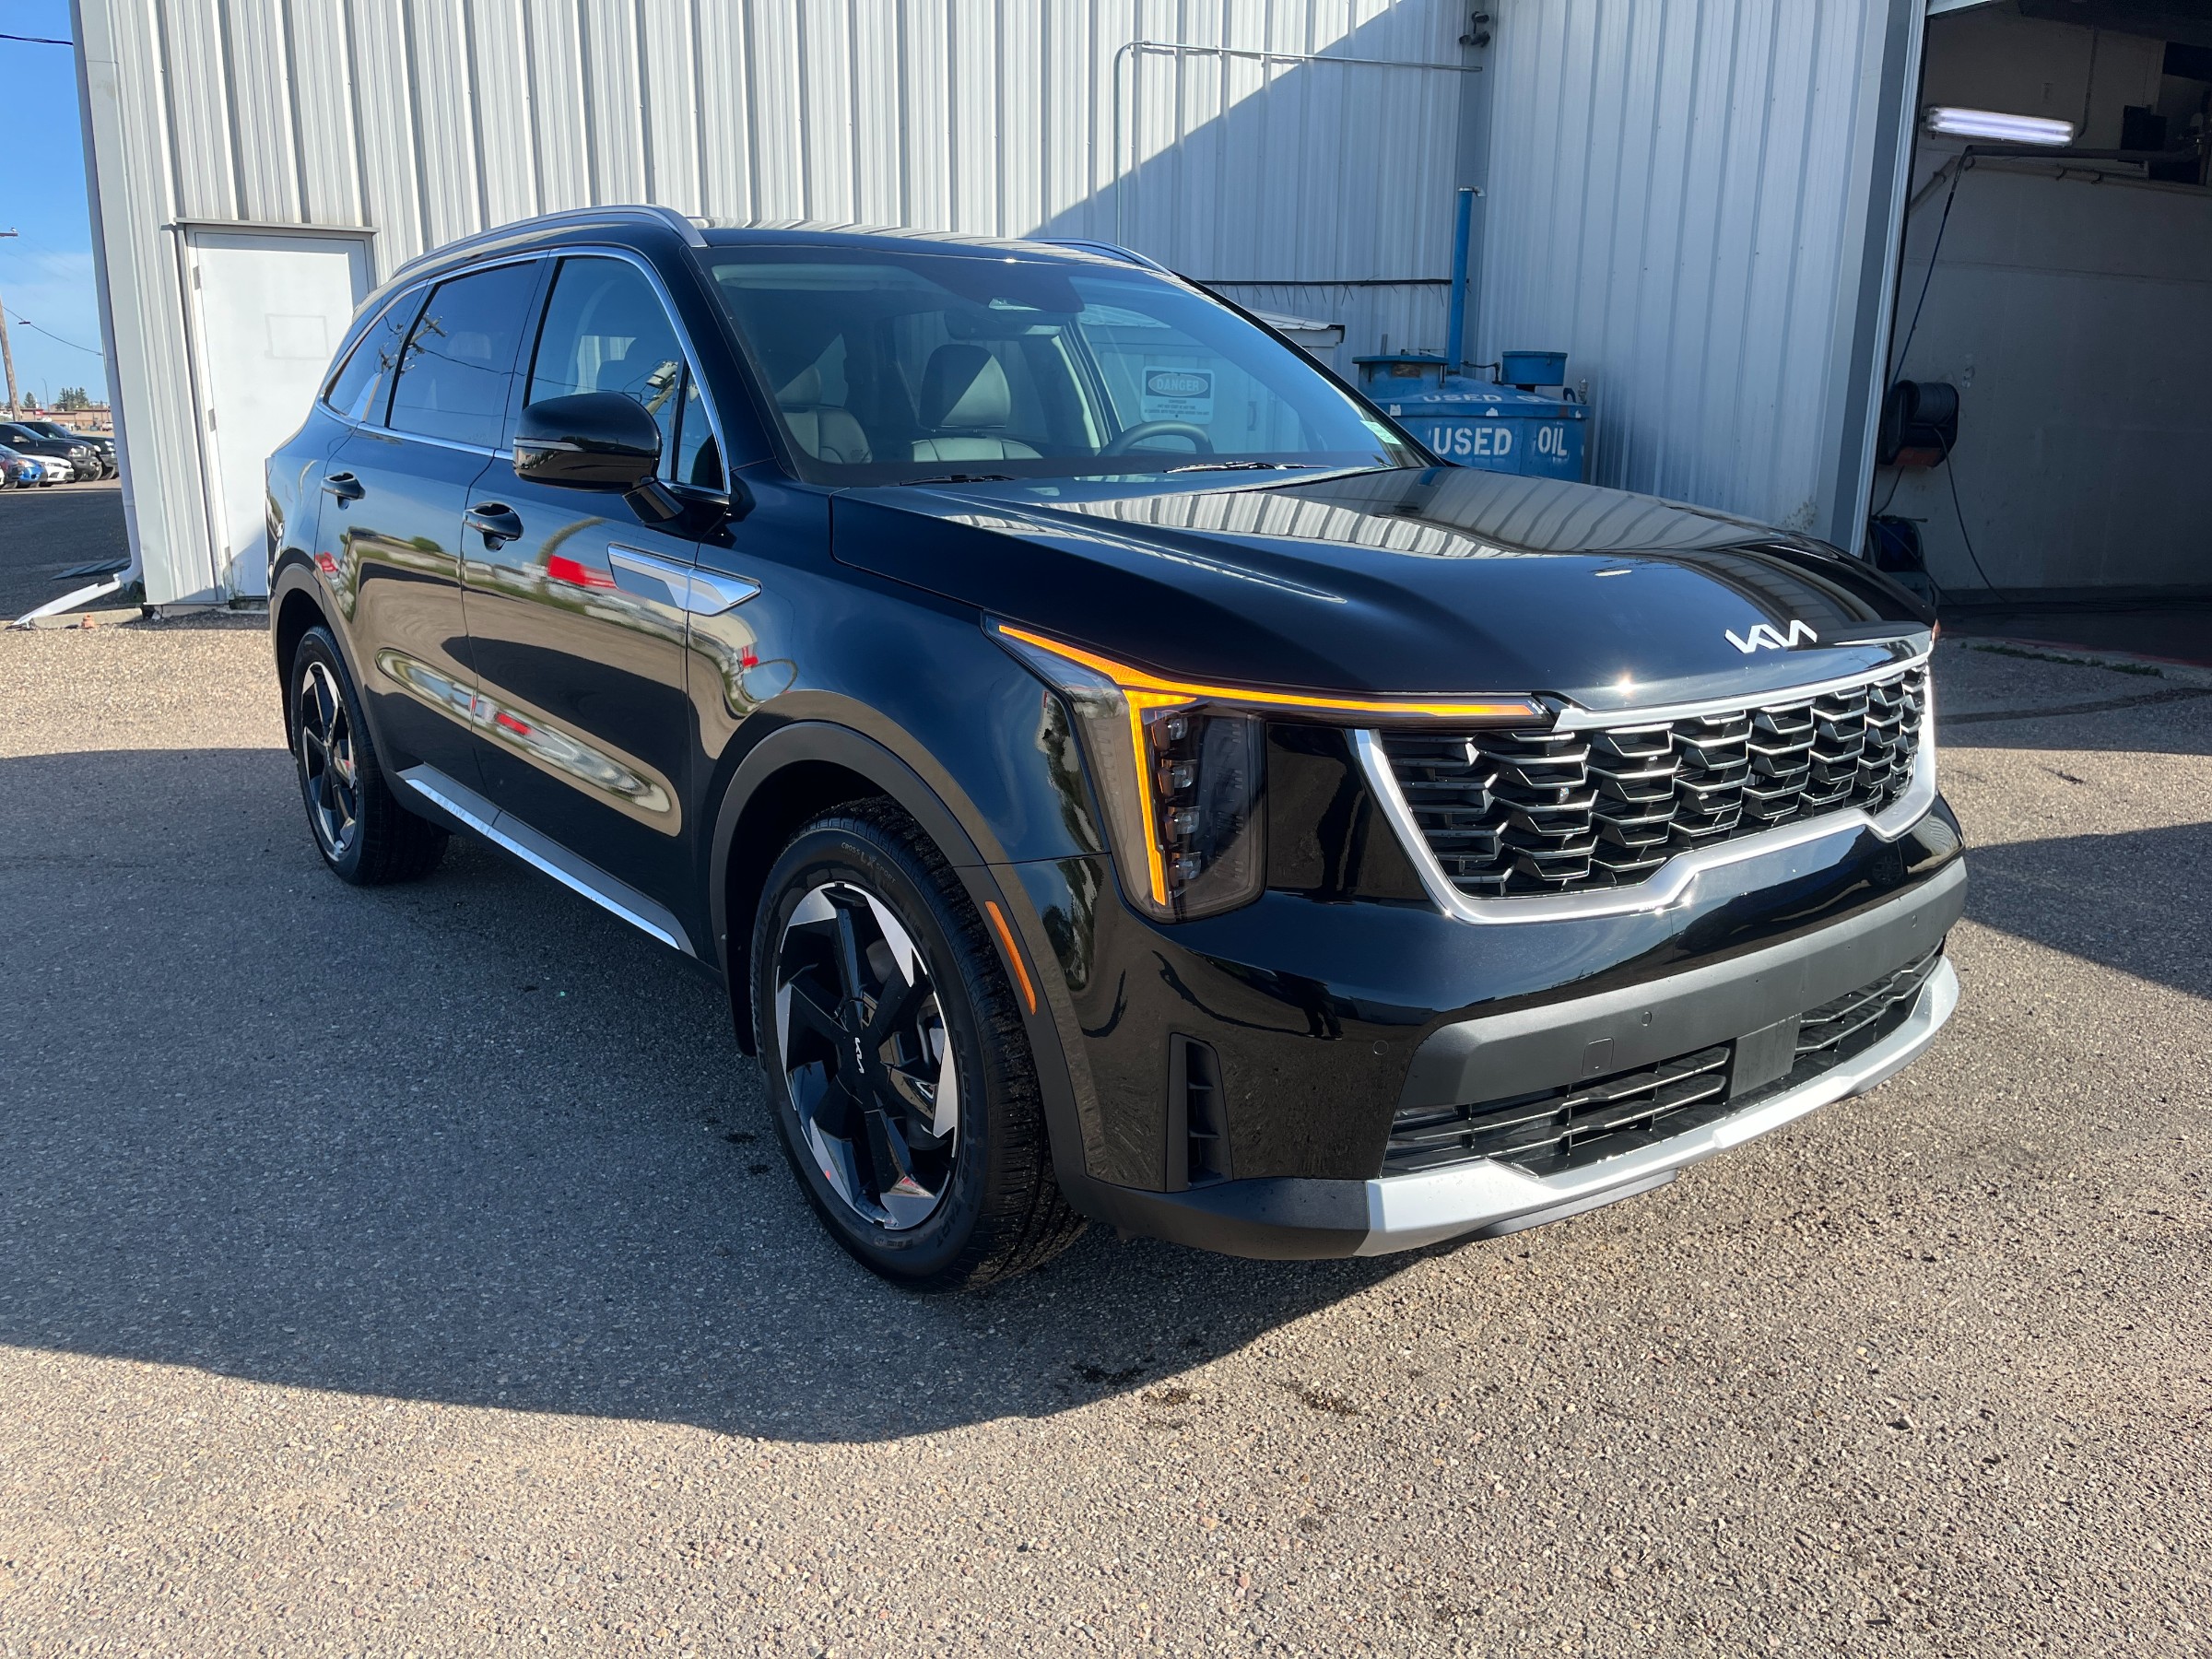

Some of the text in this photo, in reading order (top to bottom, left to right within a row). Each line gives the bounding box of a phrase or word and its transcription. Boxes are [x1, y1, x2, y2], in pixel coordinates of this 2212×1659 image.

[1157, 378, 1199, 392] DANGER
[1423, 394, 1502, 402] USED
[1433, 427, 1512, 455] USED
[1537, 426, 1568, 456] OIL
[1724, 619, 1818, 653] KIA
[841, 841, 898, 884] CROSS LX SPORT
